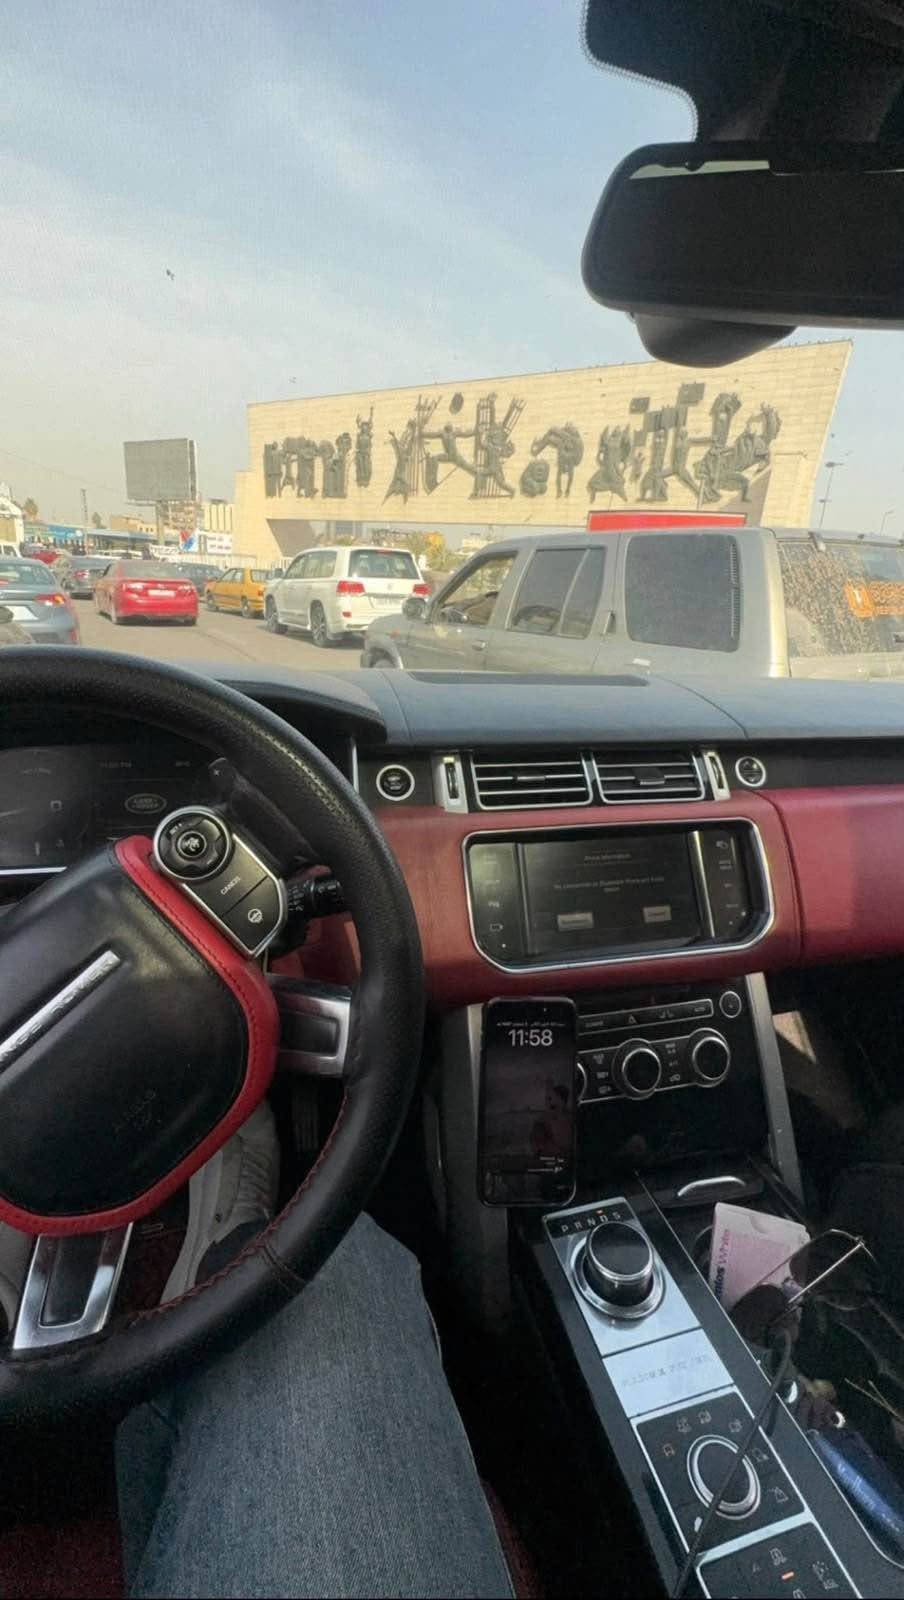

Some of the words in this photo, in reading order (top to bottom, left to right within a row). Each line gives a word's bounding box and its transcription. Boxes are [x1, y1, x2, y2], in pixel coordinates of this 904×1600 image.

[508, 1029, 553, 1046] 11:58
[561, 1224, 569, 1232] P
[587, 1218, 596, 1226] N
